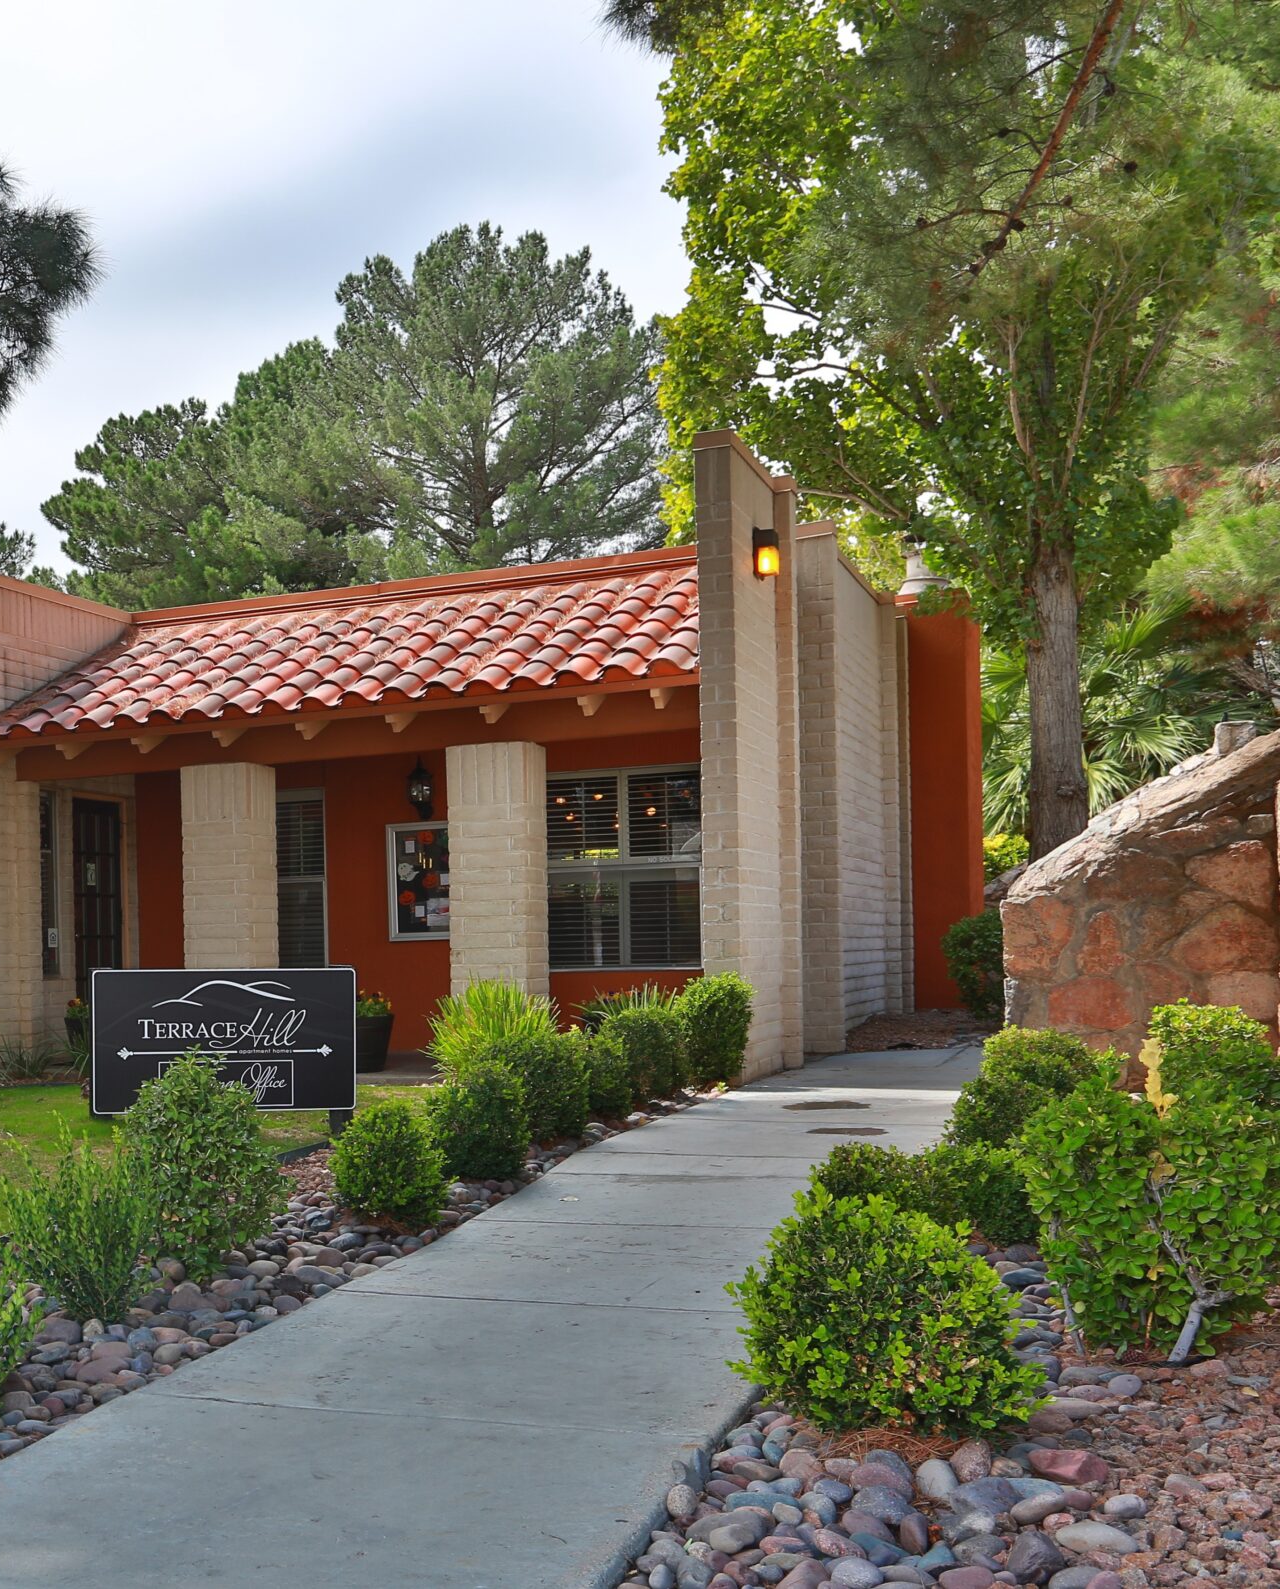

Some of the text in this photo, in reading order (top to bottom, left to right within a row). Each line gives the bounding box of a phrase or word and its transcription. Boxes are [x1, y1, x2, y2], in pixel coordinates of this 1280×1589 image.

[137, 1008, 306, 1049] TERRACE Hill
[241, 1062, 287, 1103] Office
